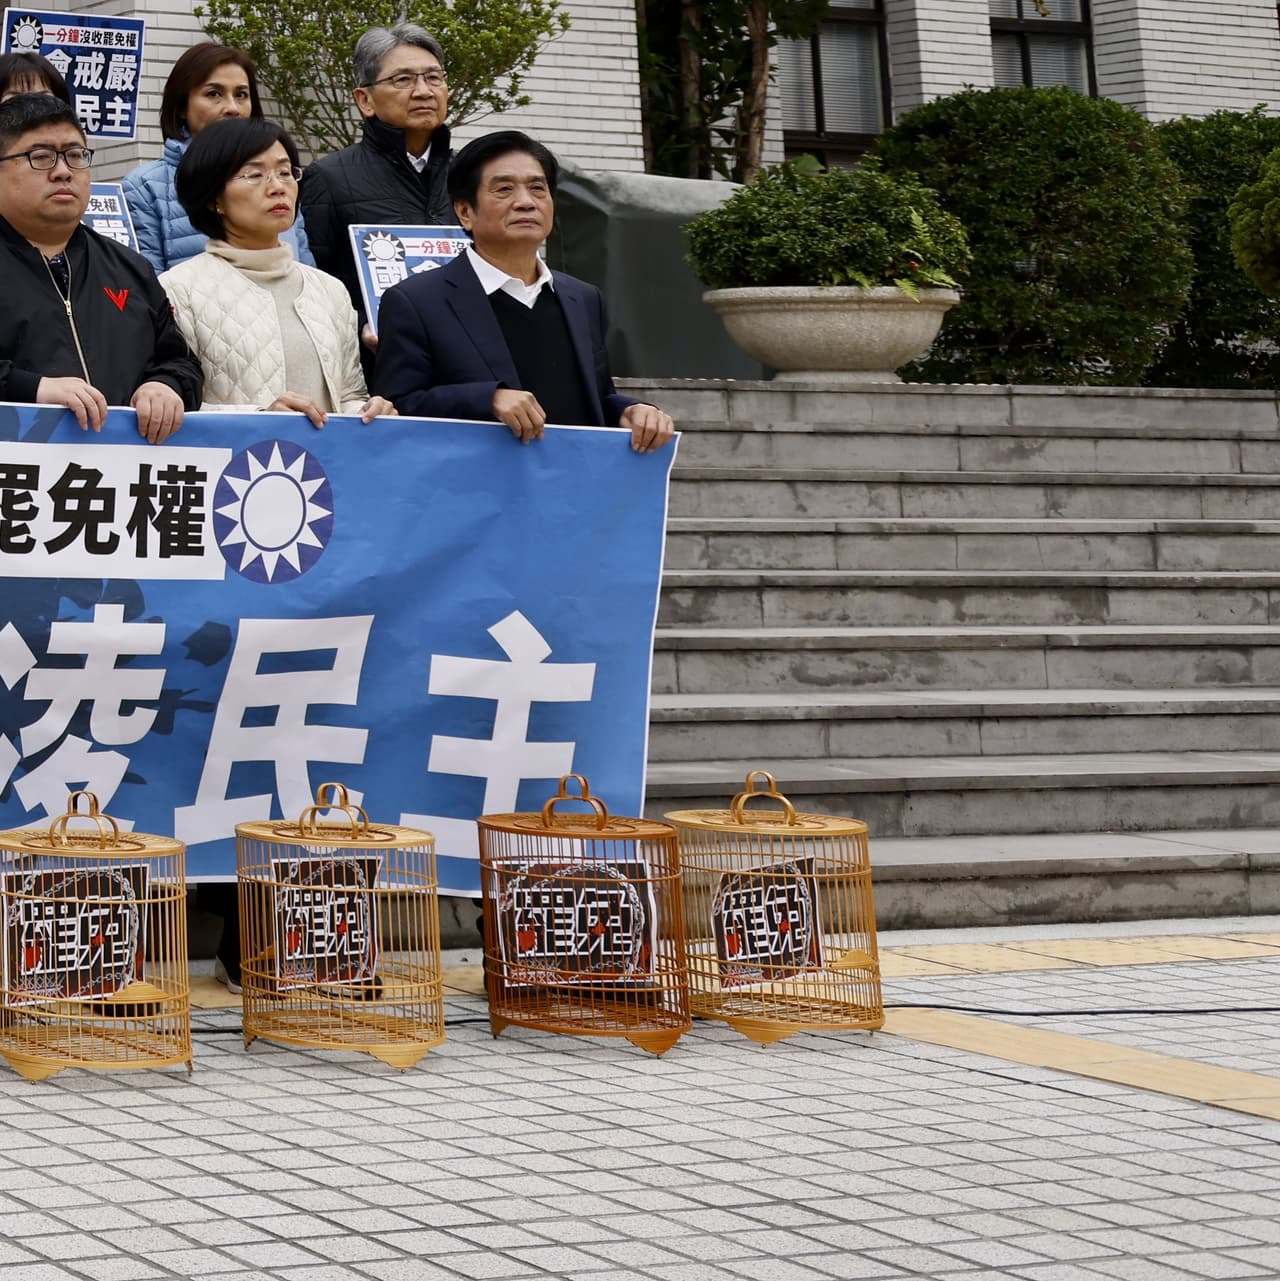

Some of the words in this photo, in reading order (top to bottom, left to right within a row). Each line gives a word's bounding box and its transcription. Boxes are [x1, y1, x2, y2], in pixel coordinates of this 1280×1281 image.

[44, 28, 136, 47] 一分鐘沒收罷免權
[75, 94, 131, 133] 民主
